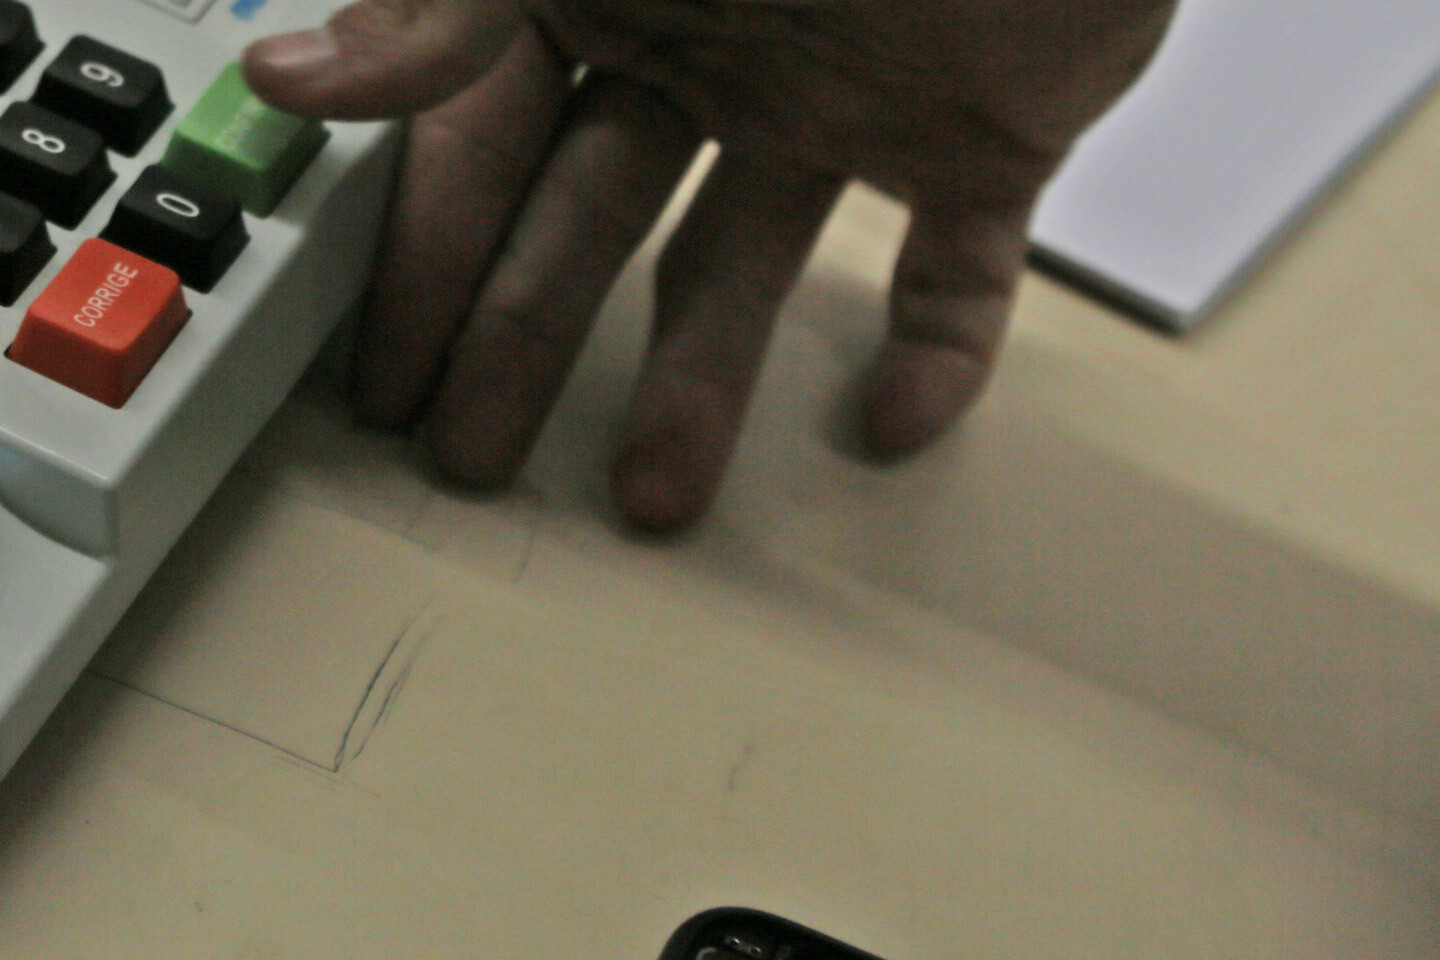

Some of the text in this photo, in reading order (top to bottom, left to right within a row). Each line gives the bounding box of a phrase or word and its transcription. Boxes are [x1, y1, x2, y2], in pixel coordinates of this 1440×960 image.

[80, 62, 123, 87] 9
[21, 128, 65, 154] 8
[156, 192, 199, 217] 0
[72, 261, 139, 328] CORRIGE
